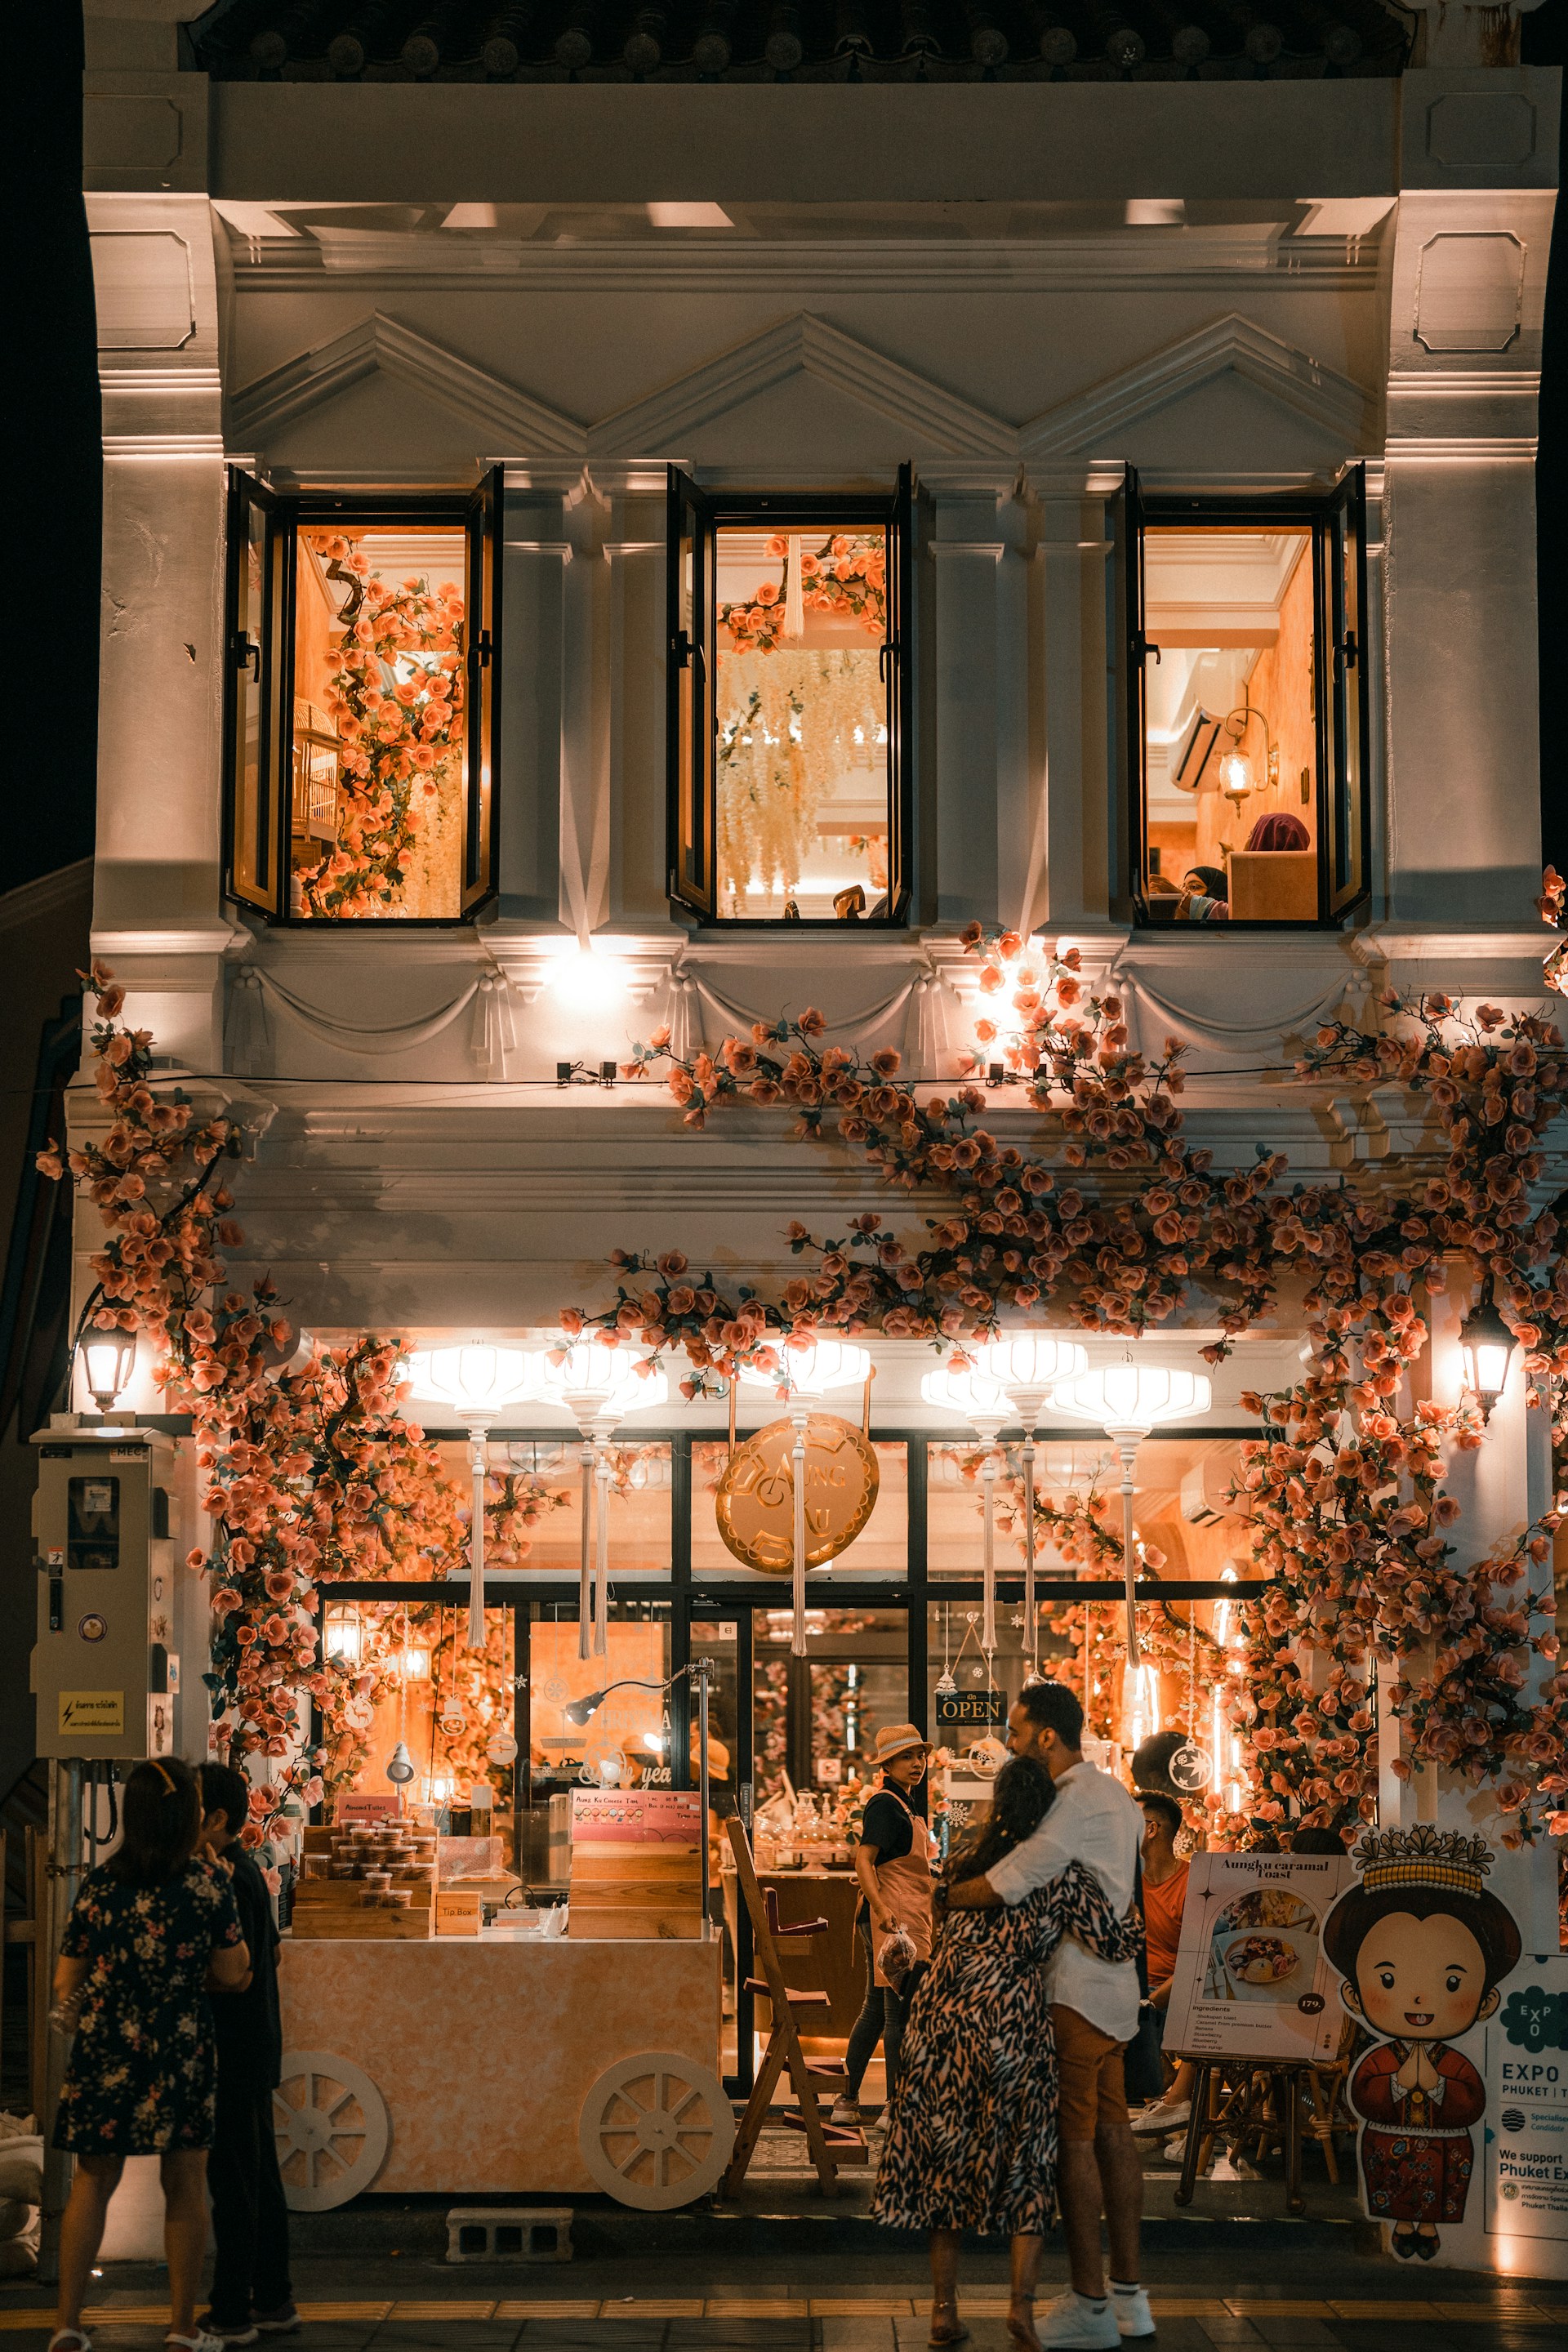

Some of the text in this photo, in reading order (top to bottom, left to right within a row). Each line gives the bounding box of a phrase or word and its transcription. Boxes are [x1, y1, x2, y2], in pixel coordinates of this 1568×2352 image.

[942, 1701, 1001, 1718] OPEN
[1221, 1859, 1329, 1872] Aungku caramal
[1257, 1869, 1291, 1879] Toast
[443, 1908, 471, 1918] Tip Box
[1502, 2063, 1559, 2083] EXPO
[1502, 2084, 1549, 2096] PHUKET
[1530, 2123, 1565, 2132] Candidate
[1499, 2149, 1563, 2164] We support
[1499, 2163, 1550, 2179] Phuket
[1521, 2201, 1546, 2210] Phuket
